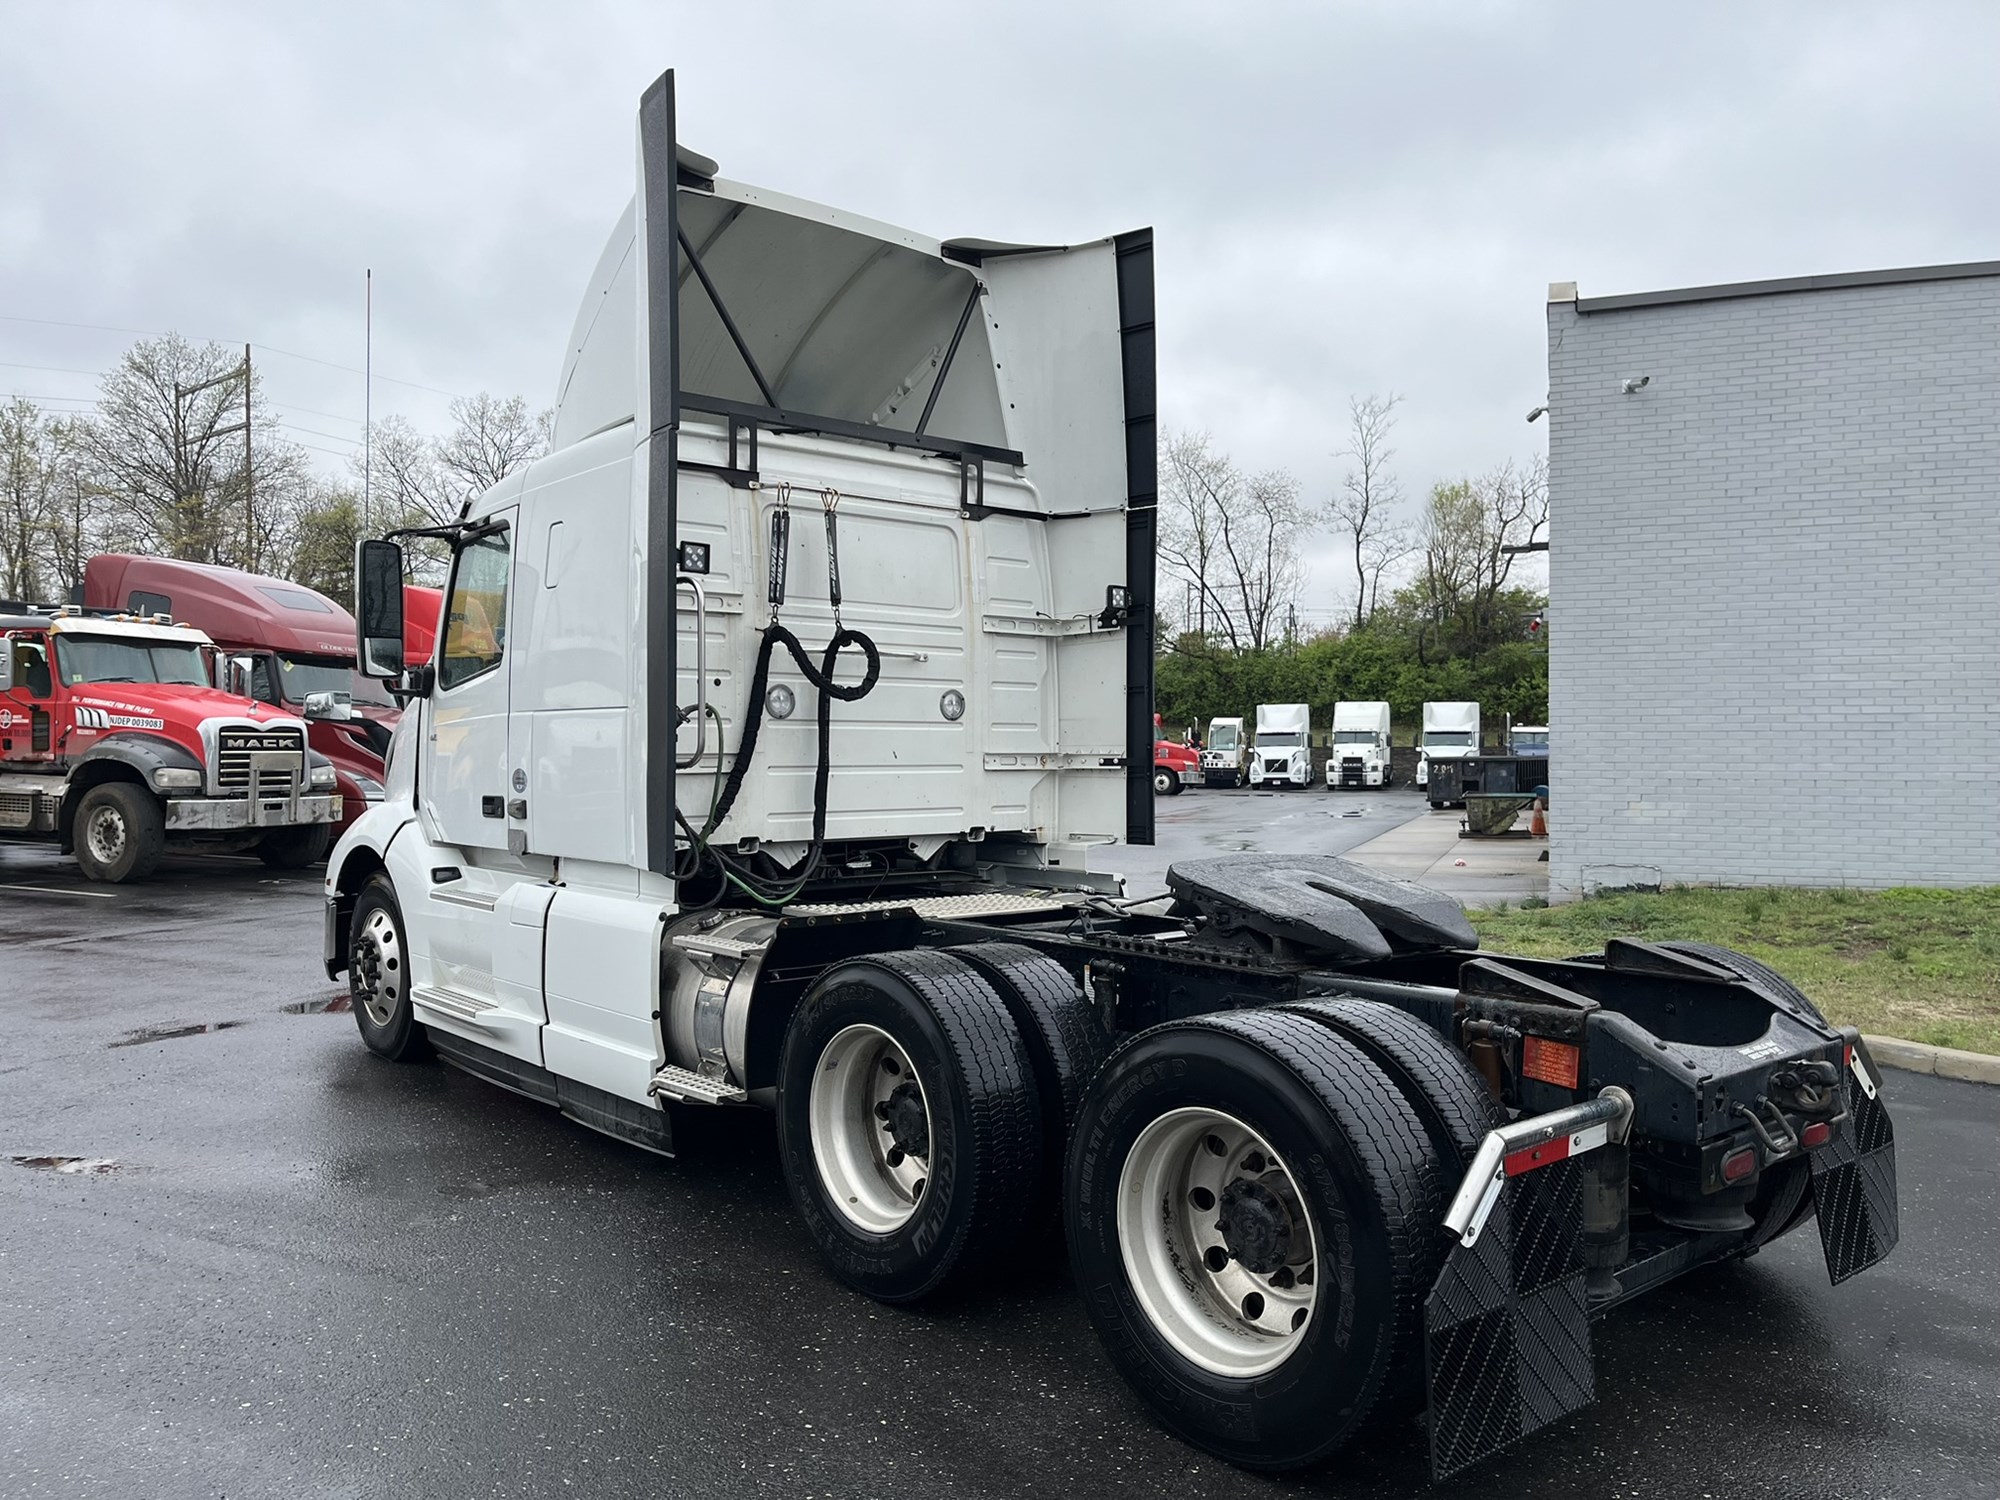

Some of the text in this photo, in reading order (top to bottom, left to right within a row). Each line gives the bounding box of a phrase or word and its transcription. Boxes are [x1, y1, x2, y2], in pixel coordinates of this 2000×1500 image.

[110, 716, 162, 728] NJDEP 0039083
[227, 739, 295, 748] MACK
[1080, 1125, 1105, 1204] MULTI
[1099, 1060, 1168, 1128] ENERGY
[912, 1118, 955, 1257] MICHELIN
